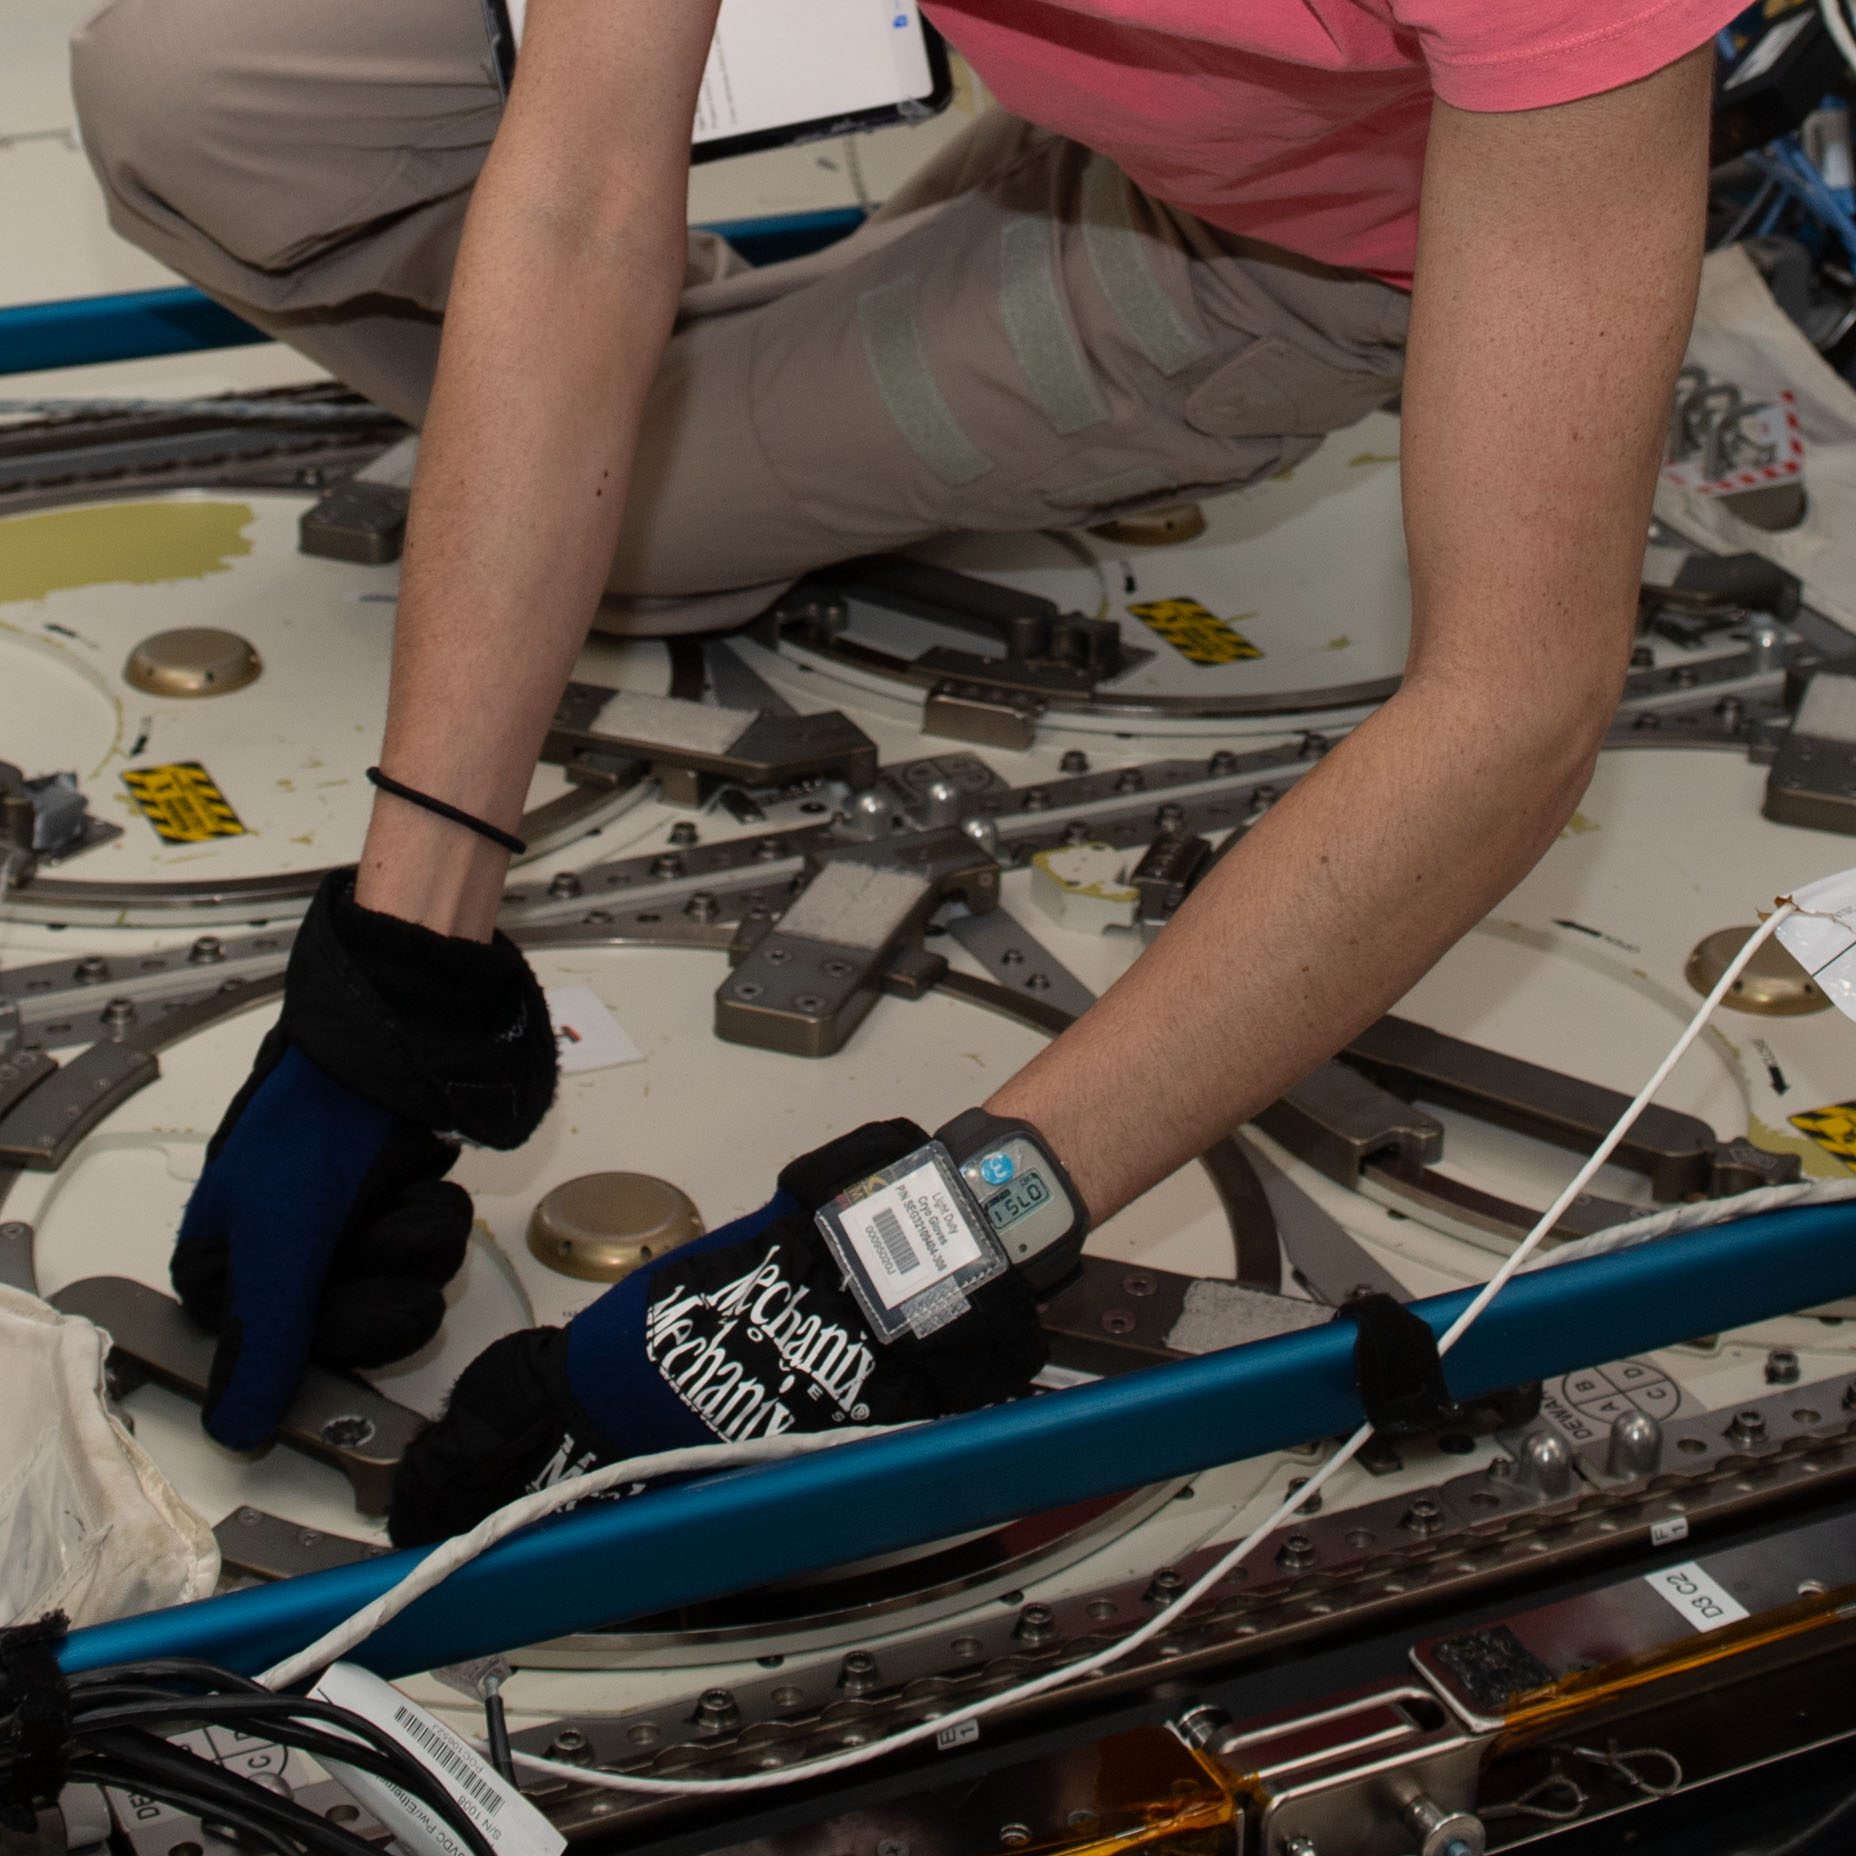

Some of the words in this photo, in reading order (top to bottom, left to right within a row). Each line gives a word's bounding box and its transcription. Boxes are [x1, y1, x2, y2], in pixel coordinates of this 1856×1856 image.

[893, 1183, 910, 1201] P/N
[914, 1194, 934, 1218] Cryo
[927, 1215, 950, 1245] Gloves
[928, 1190, 950, 1215] Light
[940, 1213, 961, 1236] Duty
[1575, 1380, 1596, 1393] B
[1623, 1367, 1645, 1379] D
[1600, 1401, 1620, 1414] A
[1647, 1387, 1667, 1400] C
[1544, 1390, 1593, 1441] DEWA
[1654, 1528, 1669, 1541] F
[1671, 1524, 1686, 1535] 1
[1666, 1572, 1698, 1595] C2
[1691, 1595, 1724, 1619] D3
[939, 1728, 956, 1745] E
[960, 1726, 975, 1738] 1
[247, 1755, 271, 1768] C
[455, 1794, 482, 1820] 1008
[480, 1817, 503, 1841] S/N
